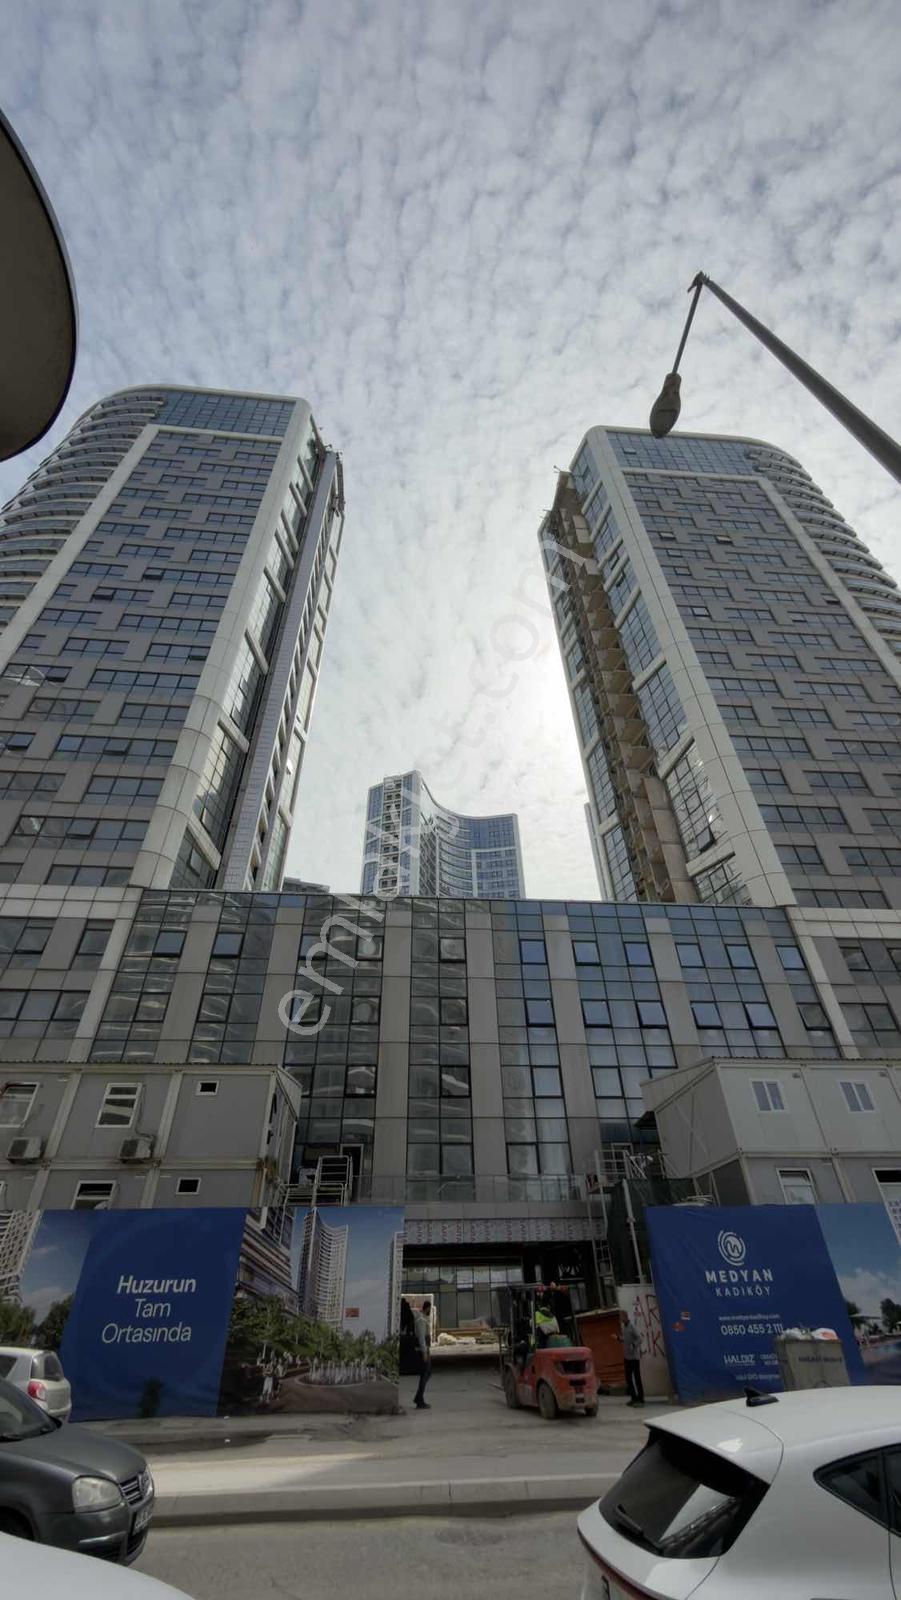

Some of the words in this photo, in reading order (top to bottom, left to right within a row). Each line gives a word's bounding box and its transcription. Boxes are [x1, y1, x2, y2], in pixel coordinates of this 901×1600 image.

[117, 1275, 197, 1294] Huzurun
[704, 1268, 774, 1284] MEDYAN
[715, 1285, 771, 1297] KADIKÖY
[134, 1298, 171, 1318] Tam
[102, 1321, 192, 1344] Ortasında
[720, 1324, 746, 1336] 0850
[747, 1323, 765, 1335] 455
